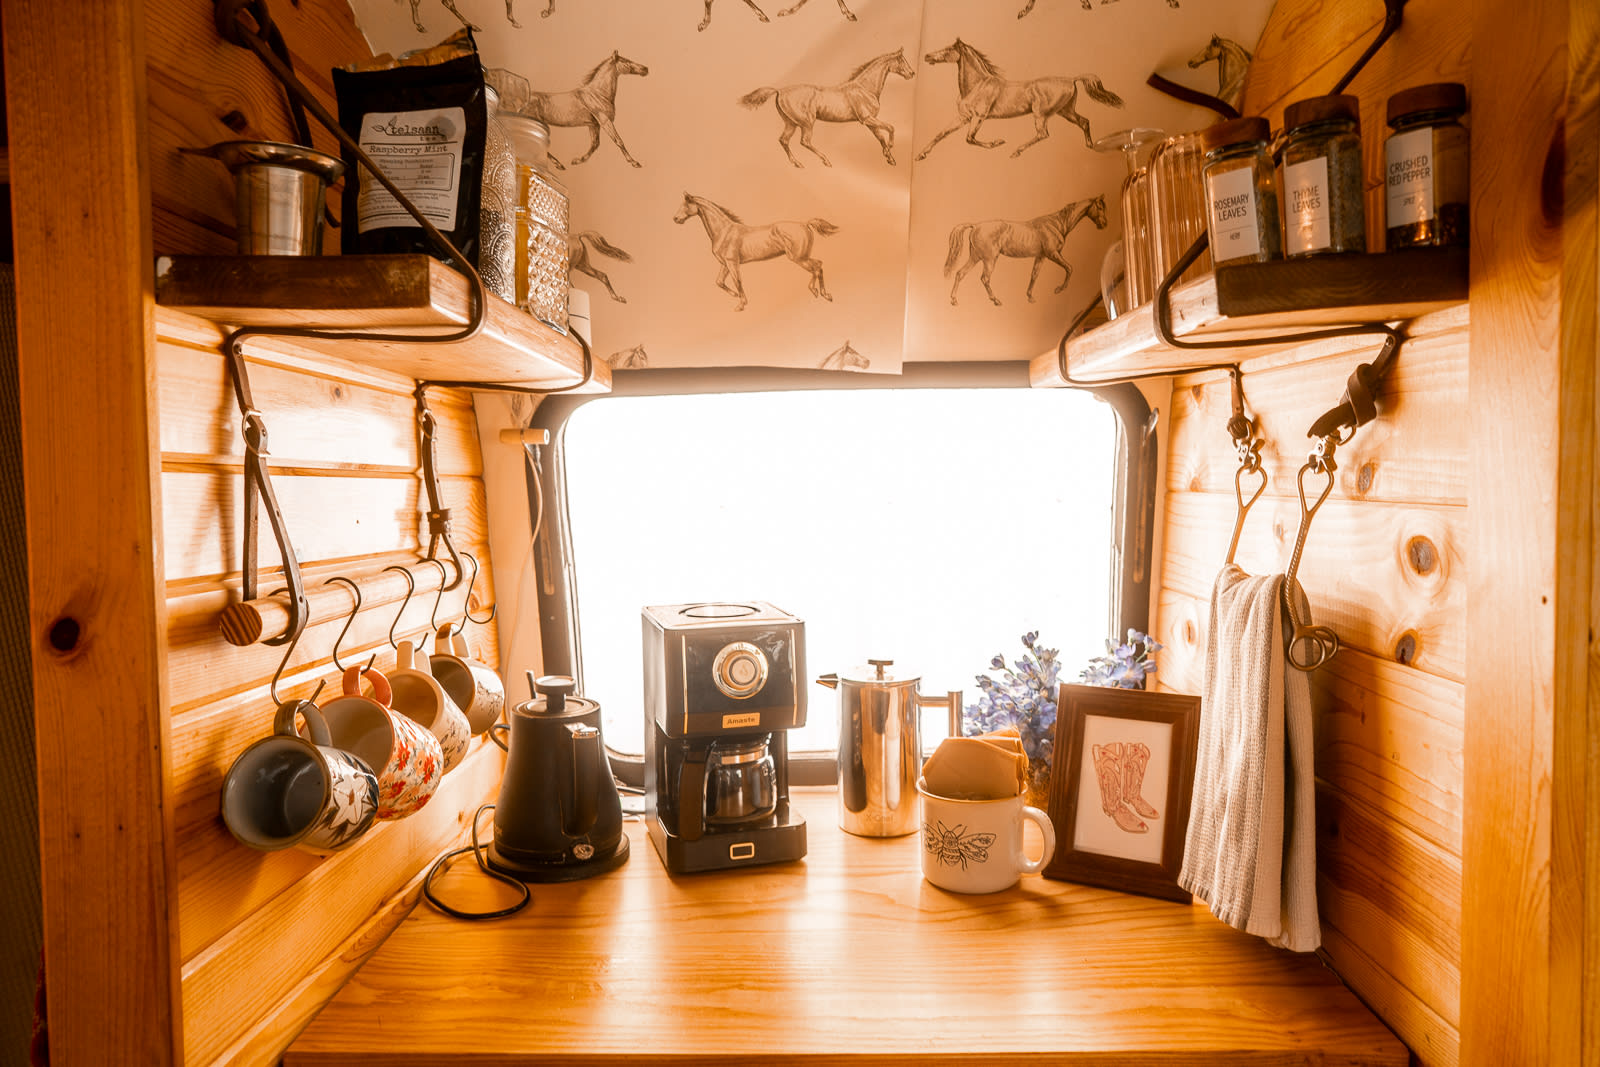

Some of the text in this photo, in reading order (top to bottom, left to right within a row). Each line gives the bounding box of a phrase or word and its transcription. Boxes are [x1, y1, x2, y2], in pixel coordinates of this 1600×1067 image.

[391, 124, 441, 135] telsaan
[369, 145, 448, 155] Raspberry Mint
[1389, 155, 1428, 175] CRUSHED
[1388, 167, 1430, 187] RED PEPPER
[1292, 185, 1320, 200] THYME
[1214, 193, 1249, 211] ROSEMARY
[1292, 198, 1321, 213] LEAVES
[1218, 206, 1247, 222] LEAVES
[727, 717, 756, 725] Amaste
